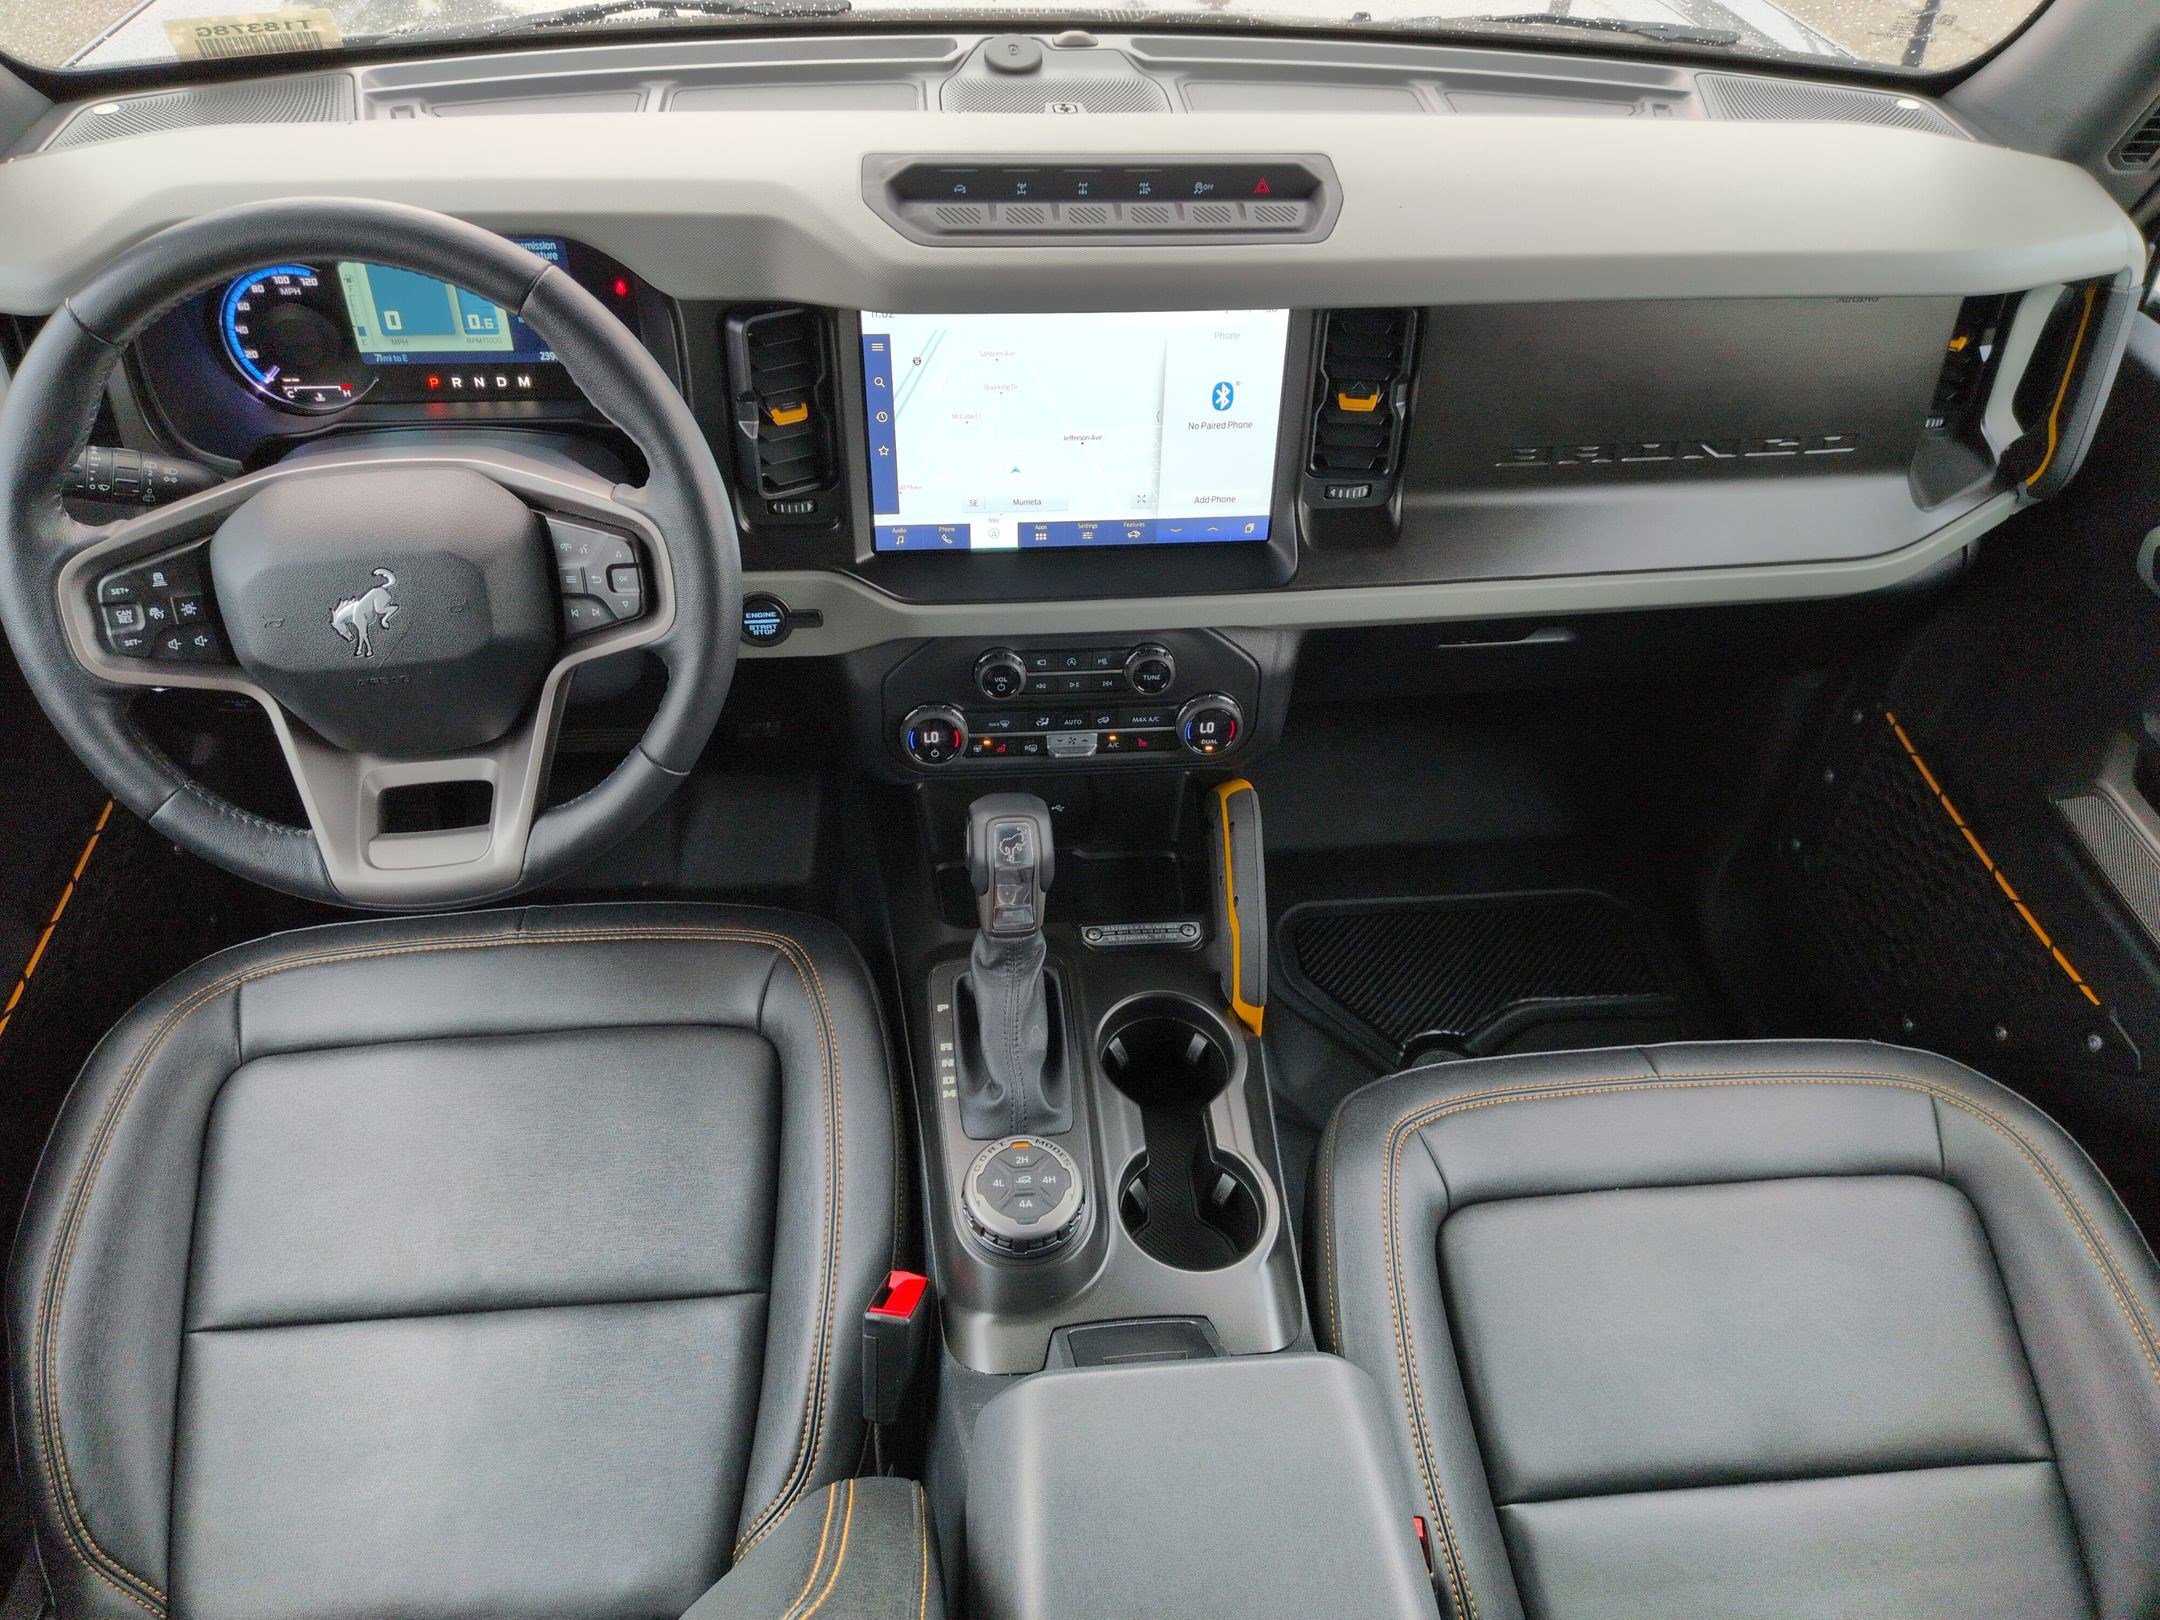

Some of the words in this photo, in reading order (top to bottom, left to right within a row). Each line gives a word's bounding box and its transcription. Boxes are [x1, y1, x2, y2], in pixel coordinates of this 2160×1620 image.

[271, 276, 290, 284] 100
[300, 278, 318, 287] 120
[251, 285, 265, 293] 80
[279, 288, 301, 296] MPH
[237, 303, 250, 311] 60
[384, 310, 402, 331] 0
[235, 326, 249, 334] 40
[1214, 331, 1241, 340] Phone
[391, 338, 408, 346] MPH
[245, 351, 259, 359] 20
[429, 377, 438, 387] P
[452, 377, 462, 388] R
[474, 377, 485, 387] N
[497, 377, 507, 387] D
[518, 376, 530, 387] M
[287, 390, 295, 399] C
[343, 390, 351, 398] H
[1188, 422, 1199, 430] No
[1201, 422, 1226, 430] Paired
[1228, 421, 1253, 429] Phone
[1194, 496, 1210, 504] Add
[1211, 495, 1236, 504] Phone
[110, 587, 129, 595] SET+
[1200, 722, 1215, 734] LO
[924, 731, 939, 743] LO
[937, 1004, 949, 1013] P
[942, 1059, 954, 1067] N
[942, 1089, 957, 1098] M
[1035, 1139, 1072, 1167] MODES
[1016, 1156, 1028, 1164] 2H
[993, 1179, 1005, 1187] 4L
[1042, 1176, 1056, 1184] 4H
[1019, 1200, 1032, 1208] 4A
